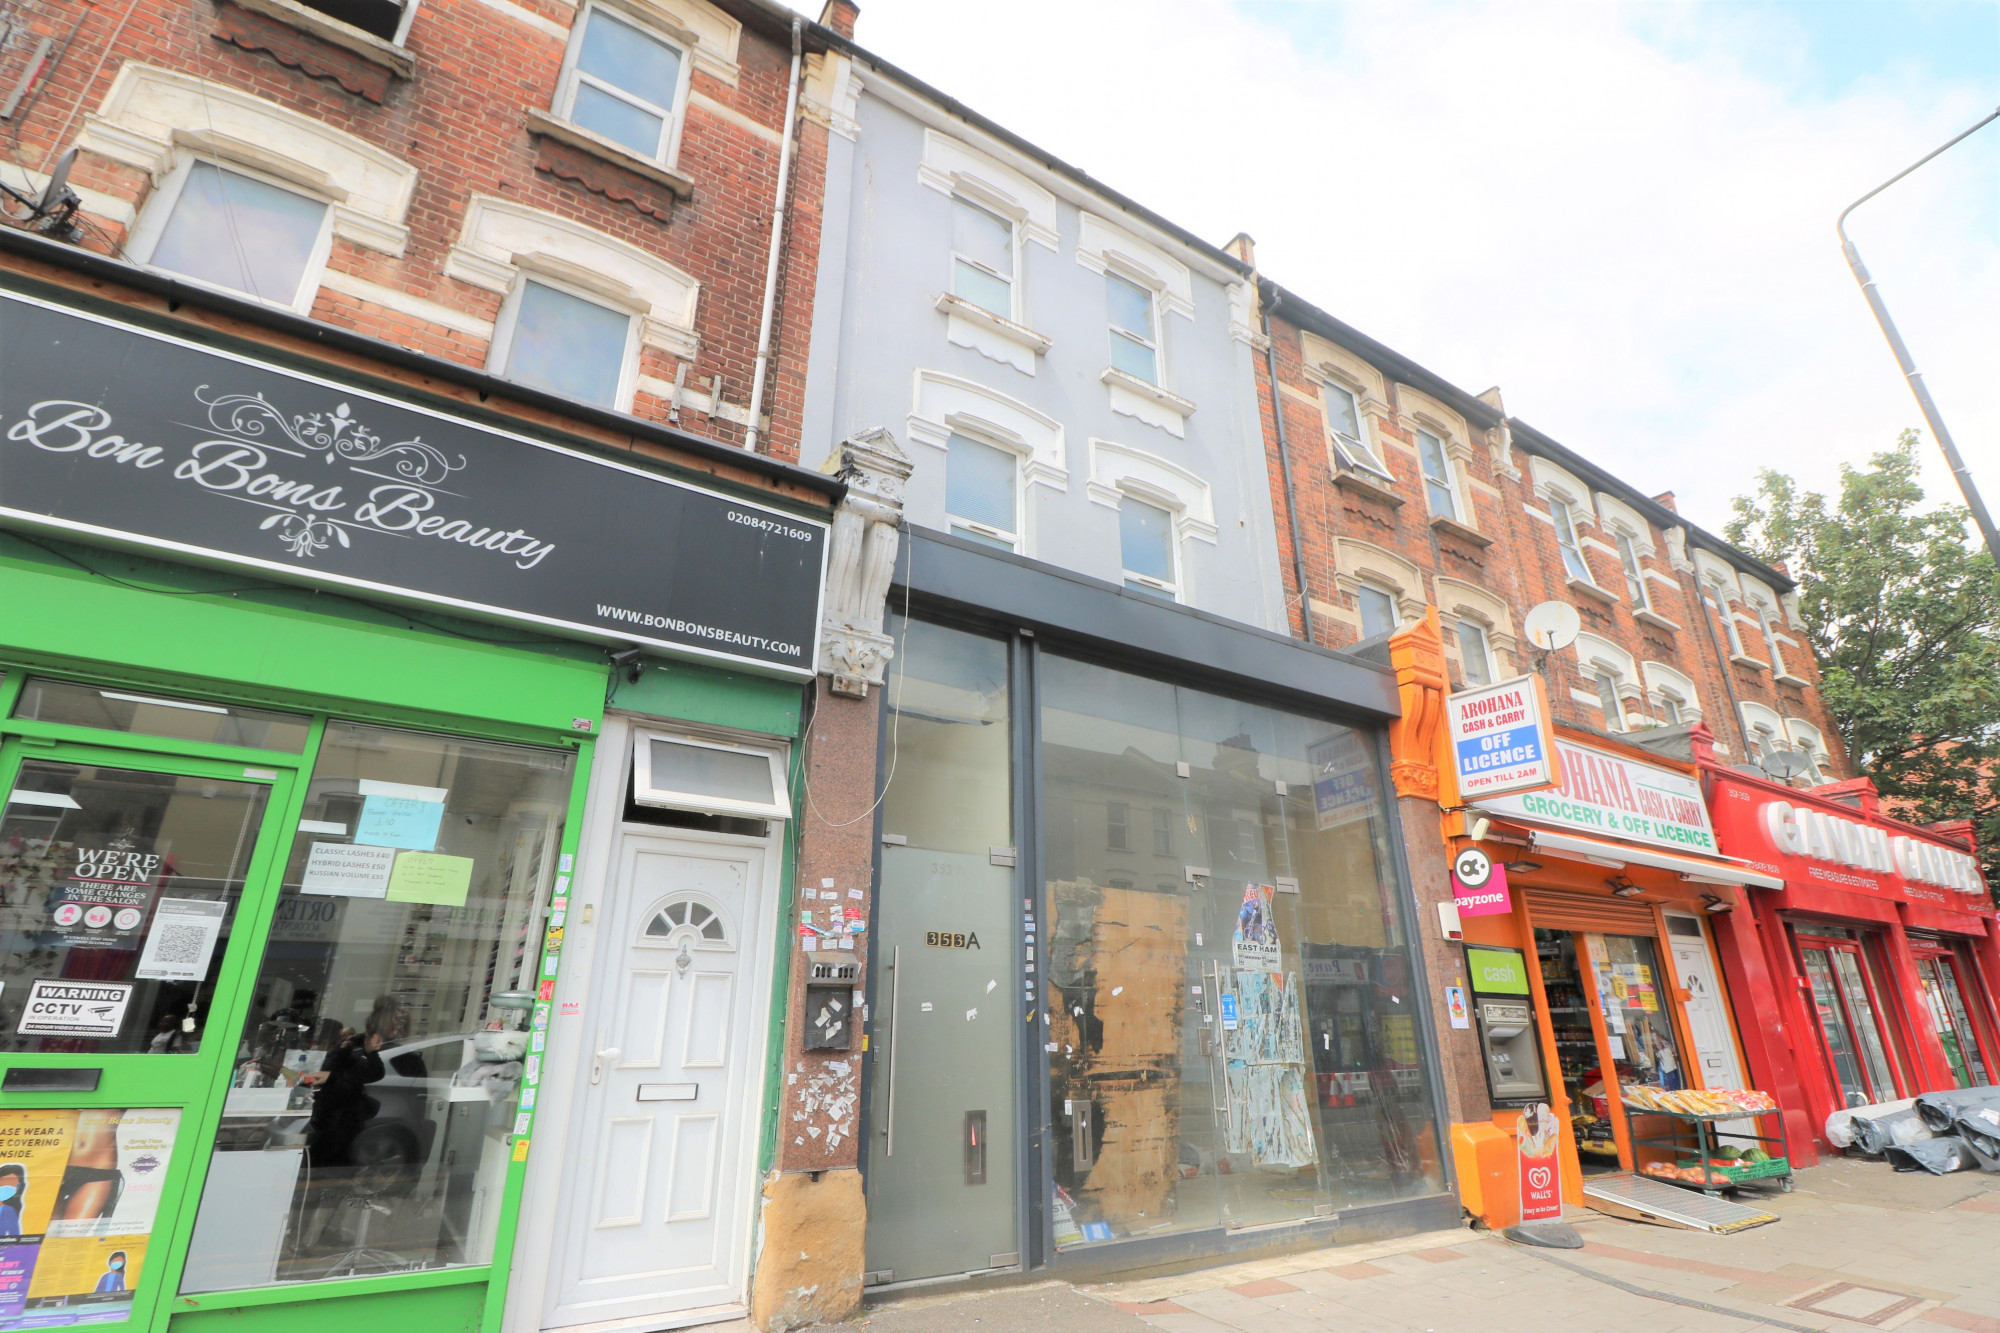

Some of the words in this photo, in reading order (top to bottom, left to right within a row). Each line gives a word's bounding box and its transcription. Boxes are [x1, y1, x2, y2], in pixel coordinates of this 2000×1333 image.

[7, 399, 164, 469] Bon
[174, 440, 346, 511] Bons
[354, 484, 555, 570] Beauty
[727, 510, 812, 542] 02084721609
[596, 603, 801, 656] WWW.BONBONSBEAUTY.COM
[1461, 691, 1523, 720] AROHANA
[1463, 719, 1486, 734] CASH
[1488, 719, 1494, 728] &
[1496, 709, 1525, 726] CARRY
[1481, 732, 1511, 751] OFF
[1463, 744, 1536, 772] LICENCE
[1467, 777, 1492, 788] OPEN
[1494, 772, 1514, 783] TILL
[1517, 768, 1537, 779] 2AM
[1539, 745, 1638, 813] OHANA
[1637, 787, 1665, 820] CASH
[1667, 799, 1675, 821] &
[1674, 797, 1704, 827] CARRY
[1522, 794, 1602, 826] GROCERY
[1608, 812, 1619, 828] &
[1623, 816, 1650, 835] OFF
[1654, 822, 1711, 847] LICENCE
[1767, 801, 1895, 873] GANDHI
[78, 848, 160, 869] WE'RE
[315, 848, 345, 856] CLASSIC
[346, 849, 375, 858] LASHES
[75, 863, 151, 882] OPEN
[311, 859, 341, 867] HYBRID
[342, 861, 370, 869] LASHES
[309, 870, 340, 878] RUSSIAN
[341, 872, 370, 880] VOLUME
[1808, 867, 1822, 879] FREE
[65, 887, 96, 895] SOME
[97, 889, 146, 899] CHANGES
[79, 882, 113, 891] THERE
[82, 895, 103, 903] THE
[105, 897, 140, 905] SALON
[1455, 892, 1504, 909] payzone
[1237, 943, 1257, 952] EAST
[1483, 964, 1516, 982] cash
[41, 987, 121, 1000] WARNING
[32, 1003, 83, 1015] CCTV
[24, 1128, 54, 1136] WEAR
[6, 1139, 60, 1147] COVERING
[1530, 1190, 1551, 1199] WALL'S
